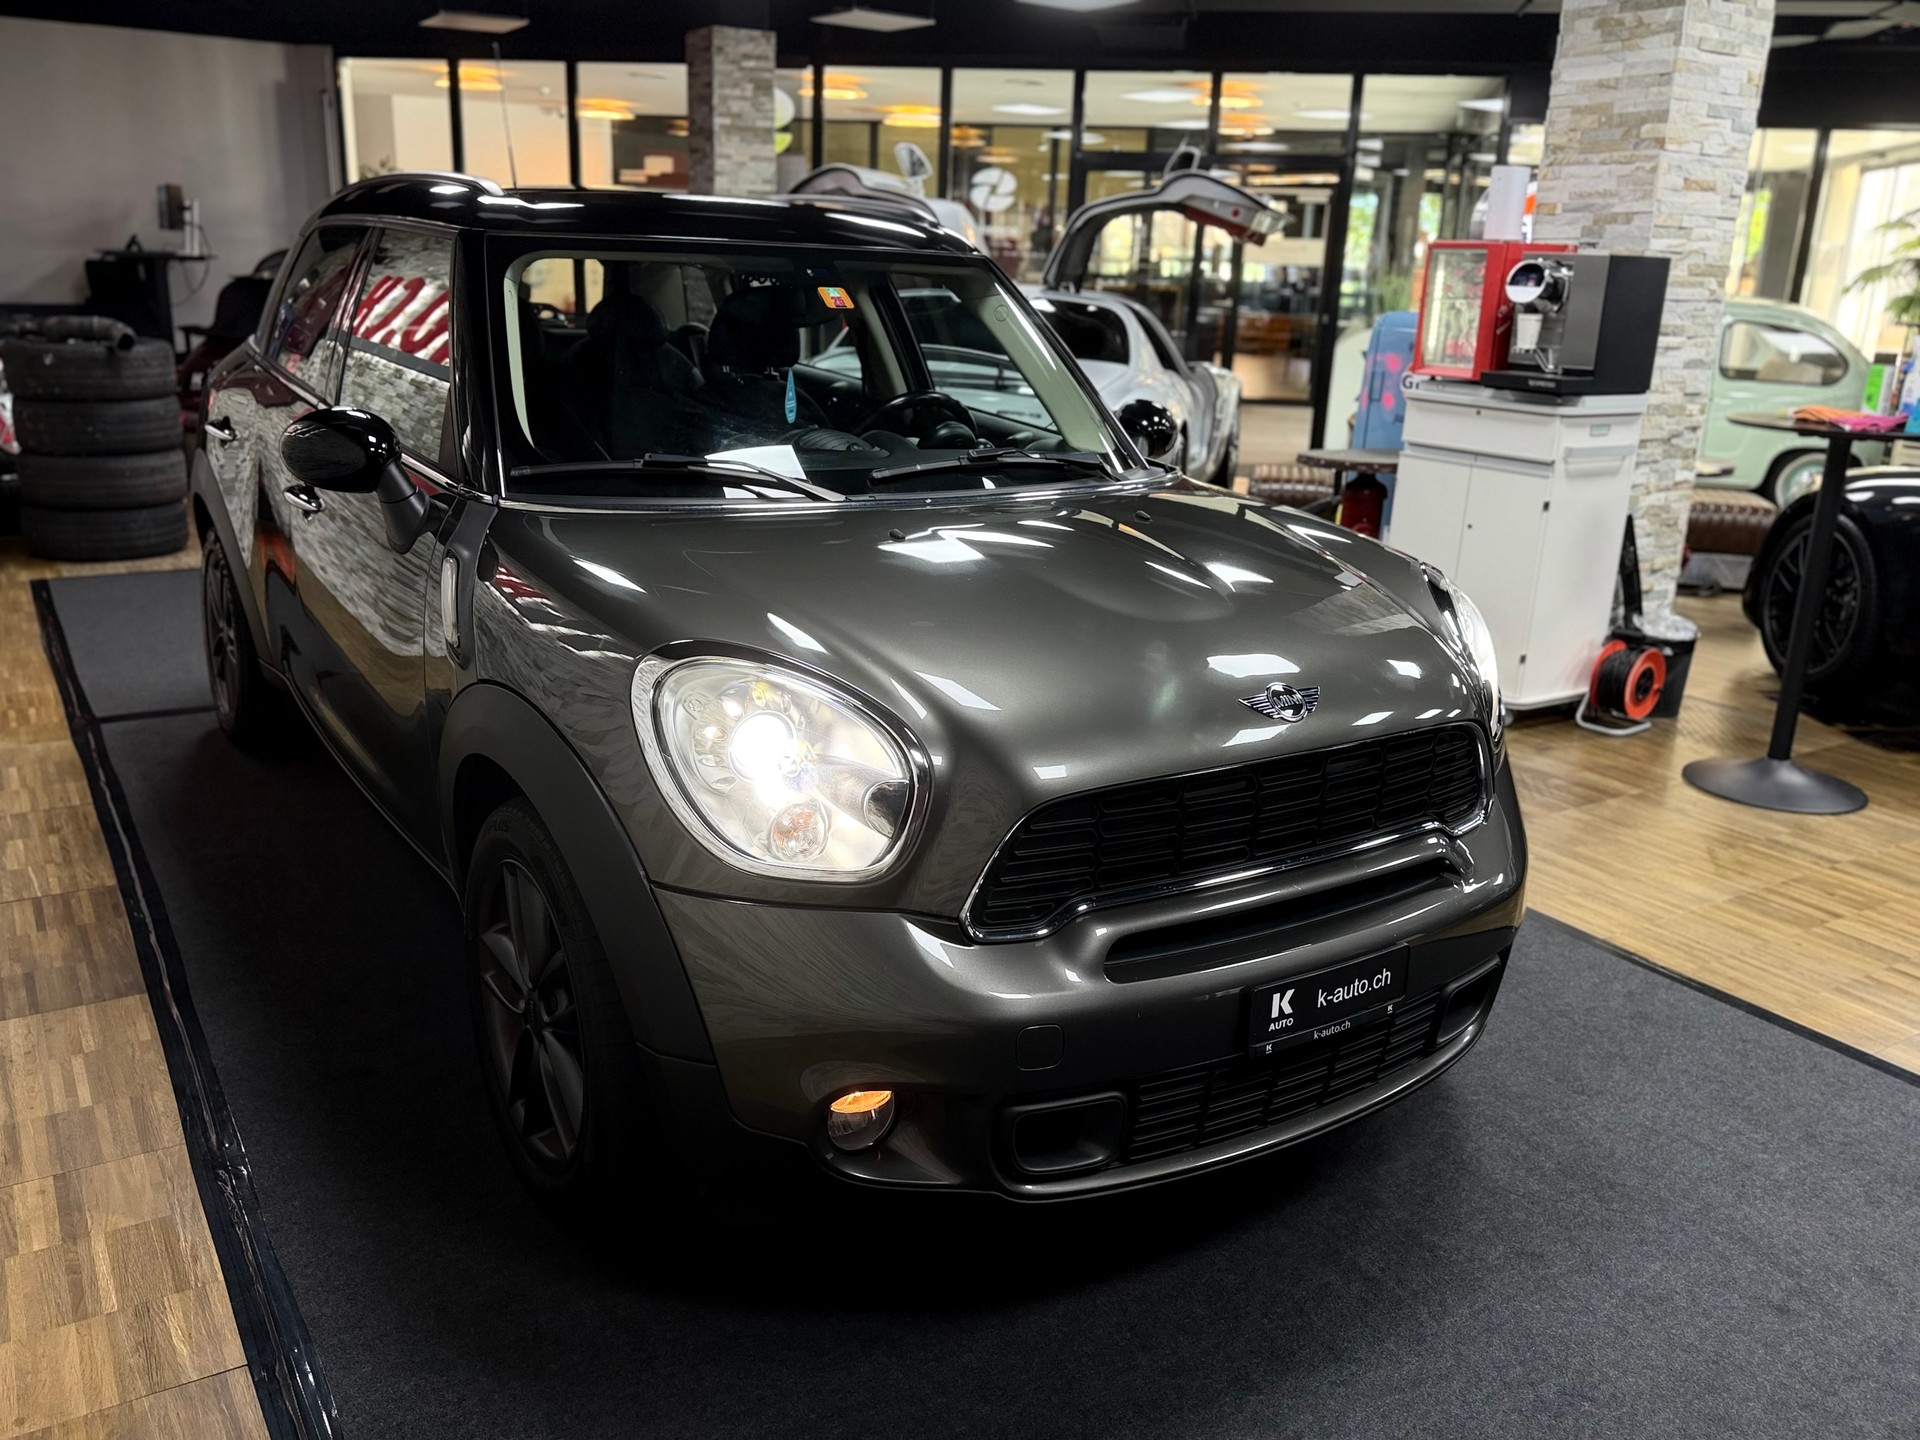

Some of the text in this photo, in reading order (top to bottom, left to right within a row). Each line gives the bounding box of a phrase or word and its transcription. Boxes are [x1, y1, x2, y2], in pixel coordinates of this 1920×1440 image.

[1273, 692, 1304, 708] MINI
[1317, 968, 1392, 1008] k-auto.ch
[1271, 988, 1296, 1019] K
[1268, 1017, 1294, 1032] AUTO
[1313, 1019, 1351, 1040] k-auto.ch
